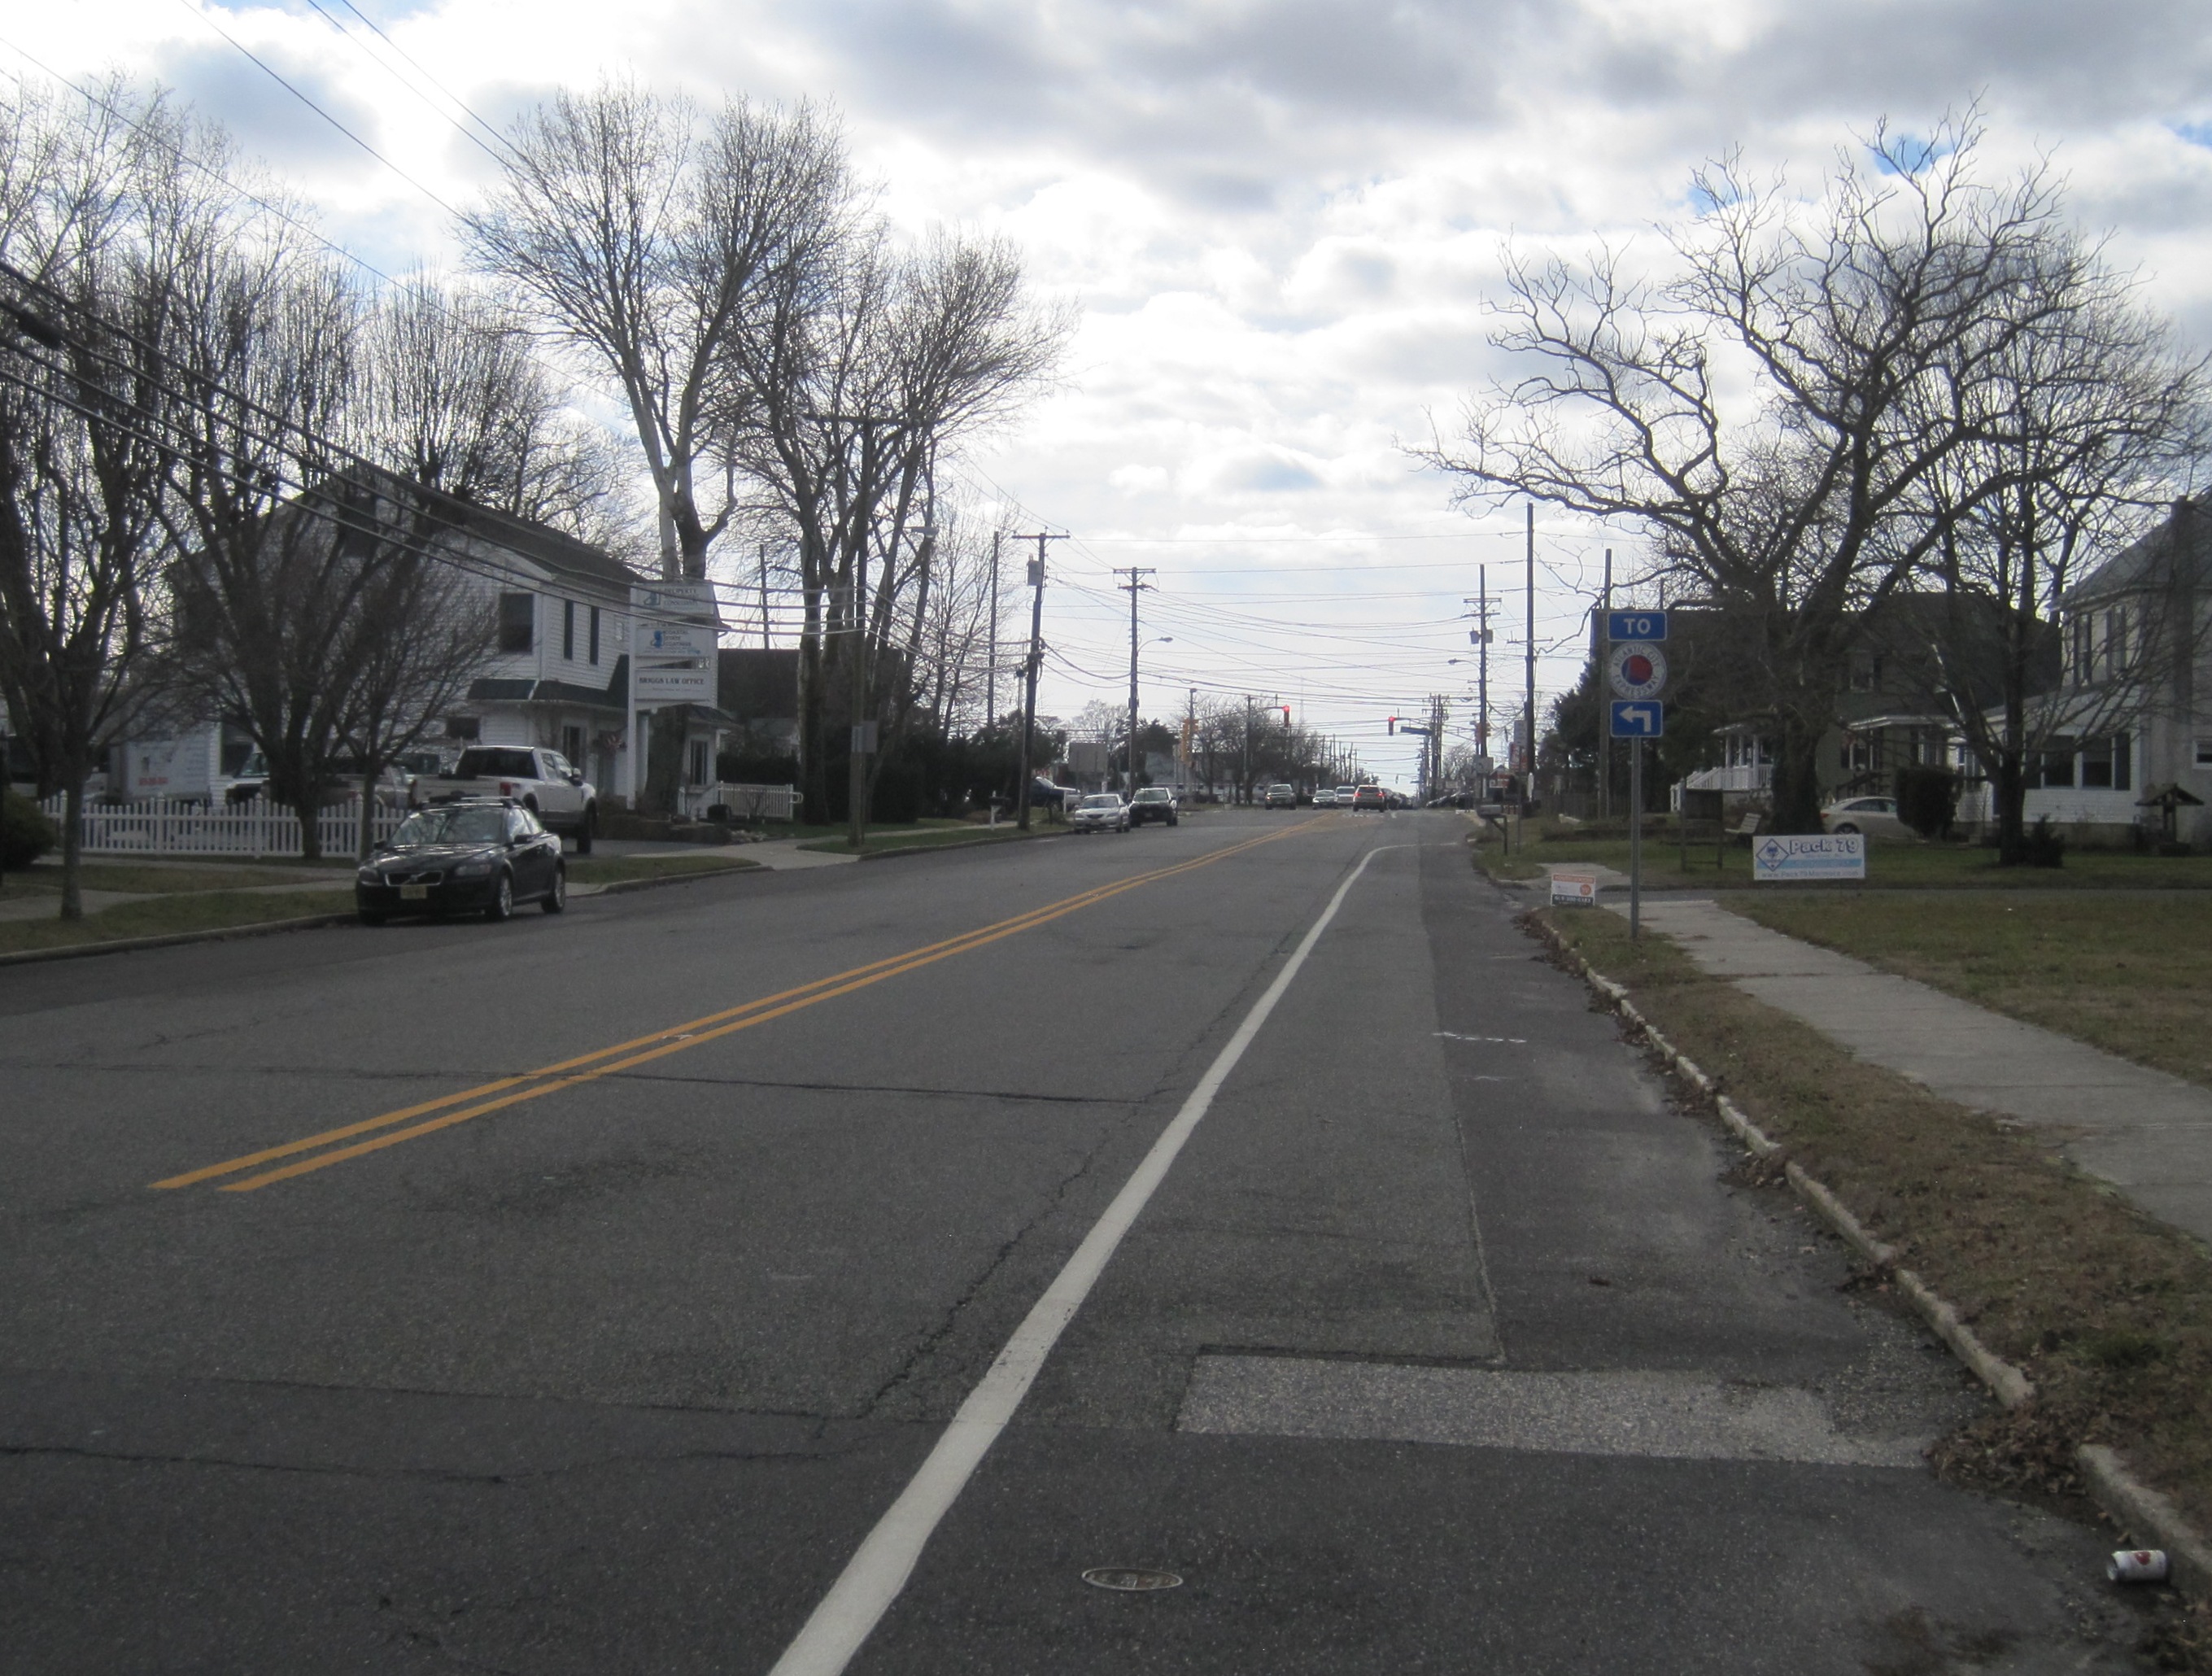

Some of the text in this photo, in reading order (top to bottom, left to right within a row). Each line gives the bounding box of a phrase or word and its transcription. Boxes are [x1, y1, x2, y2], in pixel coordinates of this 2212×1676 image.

[1623, 618, 1651, 634] TO
[1613, 645, 1661, 667] ATLANTIC CITY
[665, 677, 679, 685] LAW
[1613, 674, 1660, 696] EXPRESSWAY
[1790, 838, 1859, 854] Pack 79
